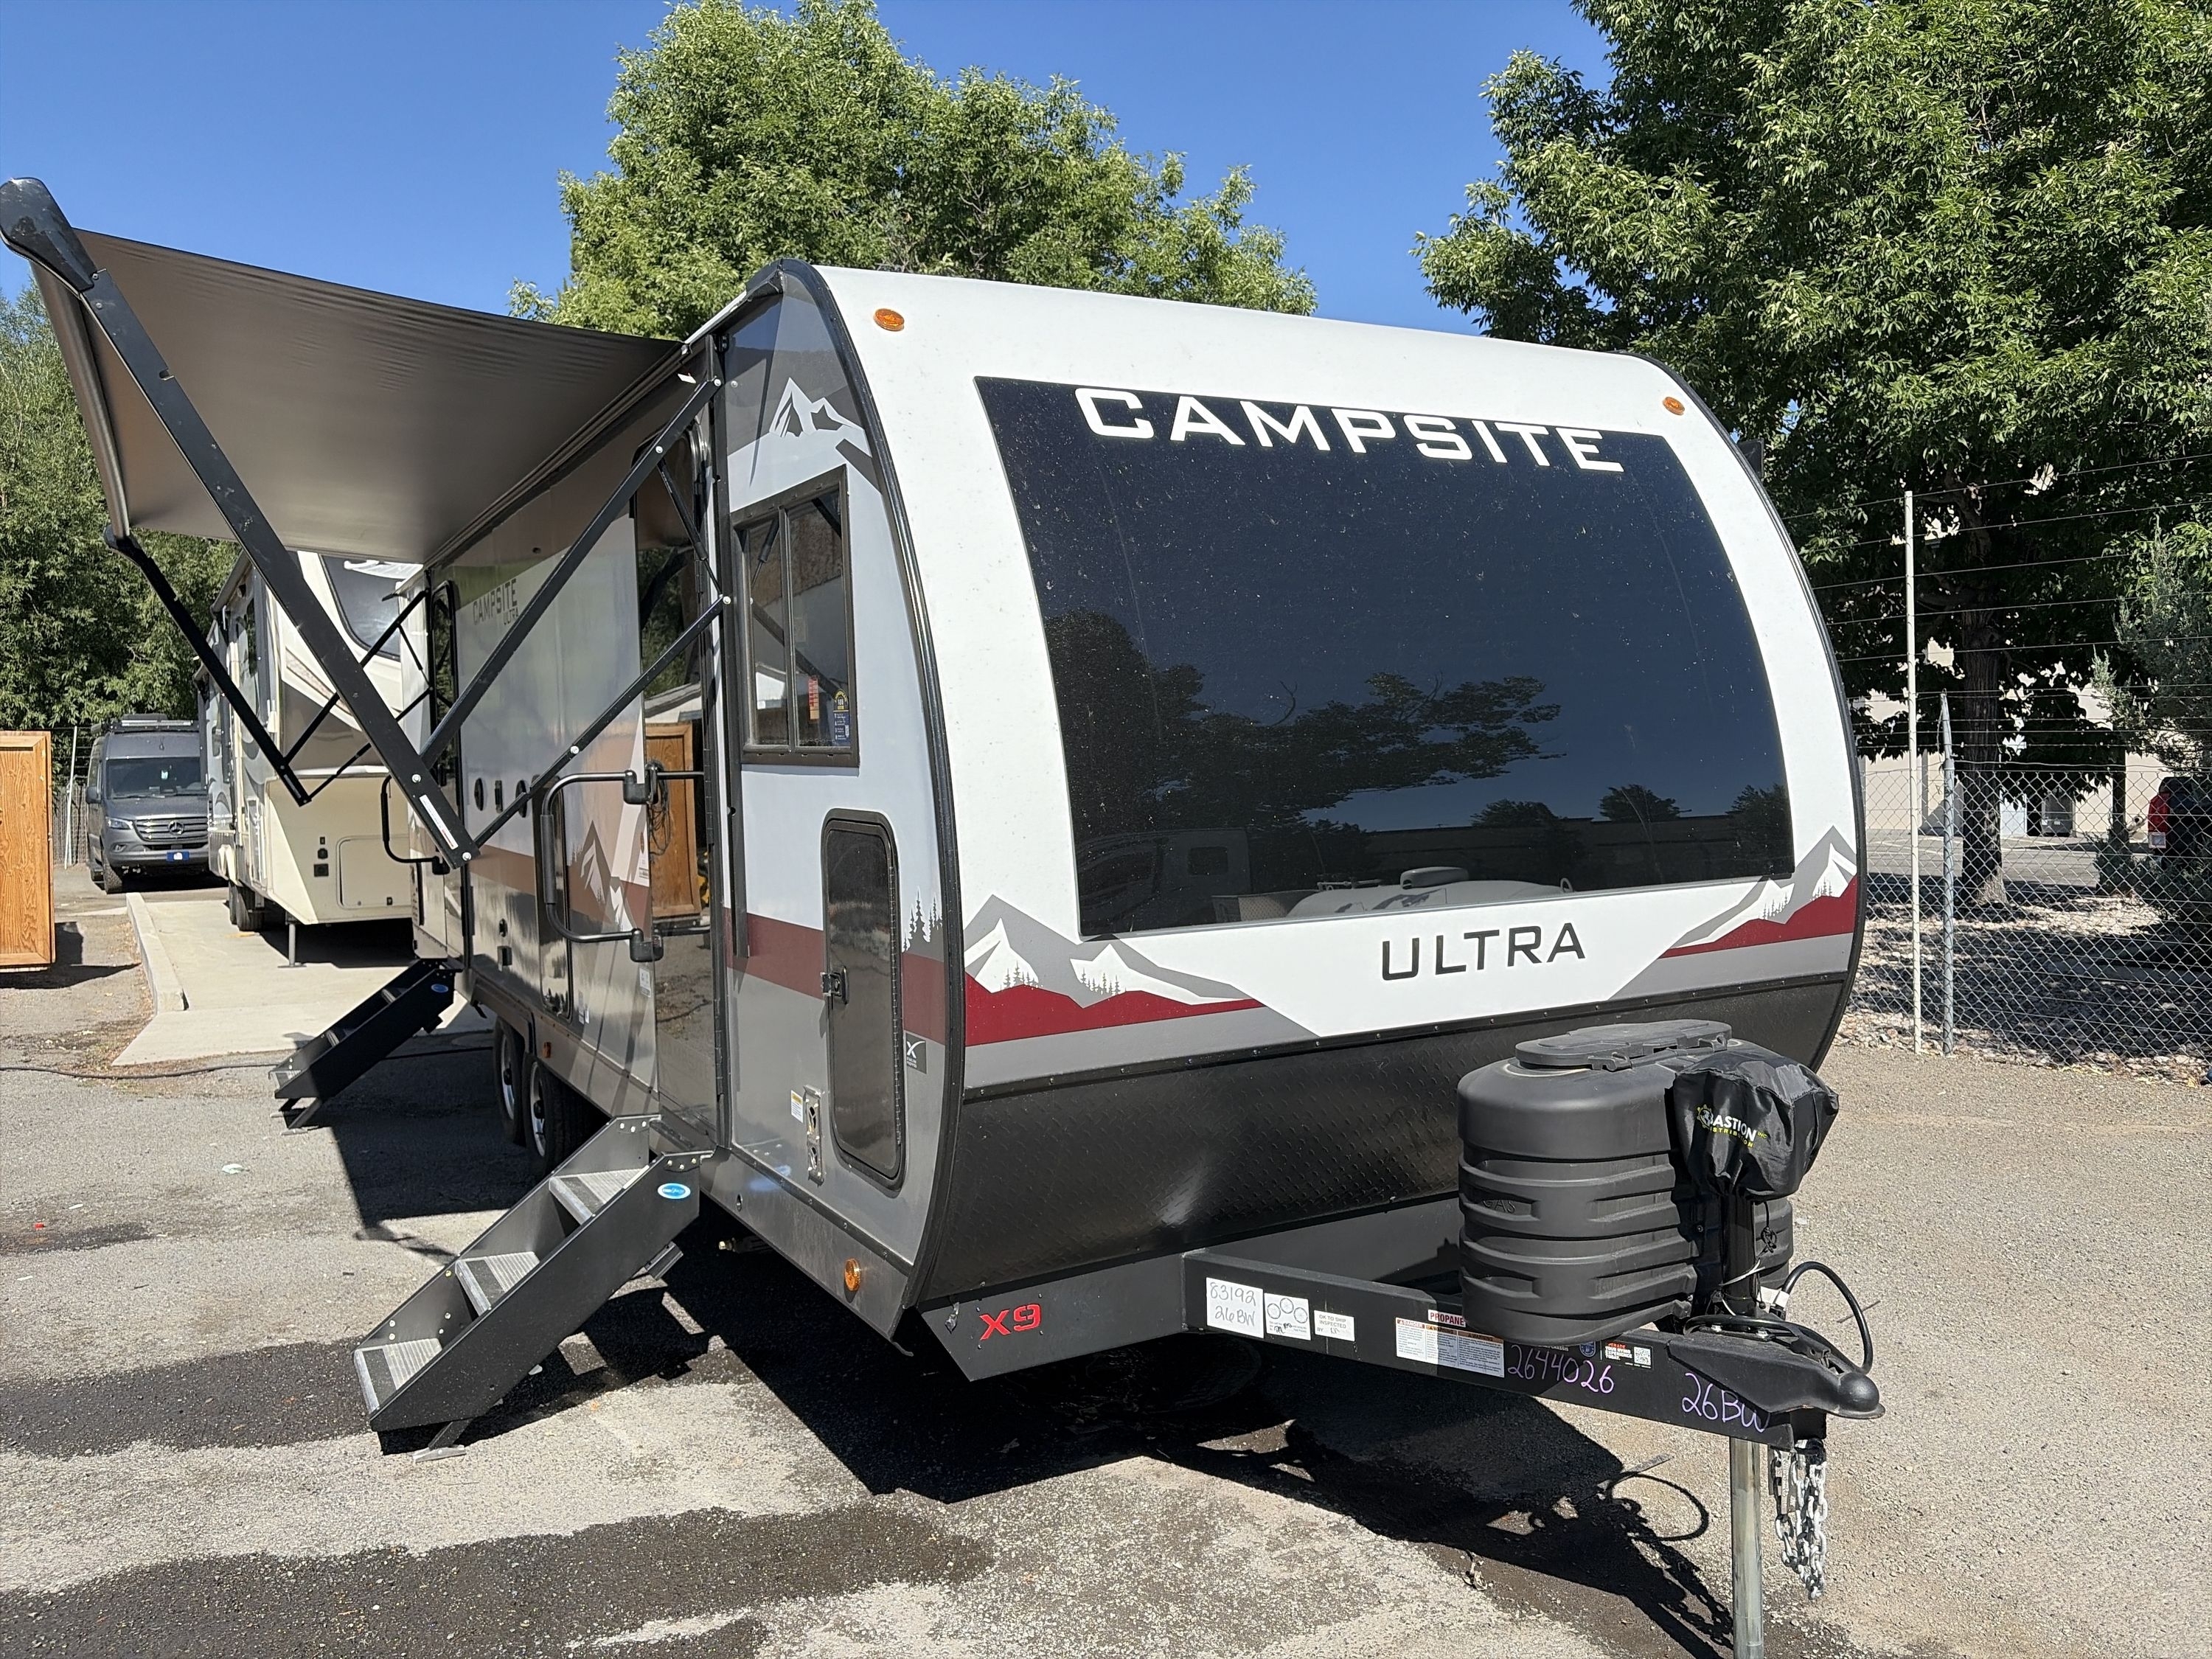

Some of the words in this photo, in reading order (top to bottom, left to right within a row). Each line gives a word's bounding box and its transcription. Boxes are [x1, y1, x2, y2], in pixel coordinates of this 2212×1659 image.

[1075, 387, 1624, 473] CAMPSITE
[473, 578, 518, 625] CAMPSITE
[1382, 922, 1585, 981] ULTRA
[1210, 1281, 1256, 1307] 83192
[979, 1303, 1042, 1340] X9
[1214, 1305, 1255, 1326] 26BW
[1319, 1320, 1346, 1329] INSPECTED
[1403, 1321, 1424, 1329] DANGER
[1430, 1312, 1464, 1326] PROPANE
[1507, 1343, 1615, 1394] 2644026
